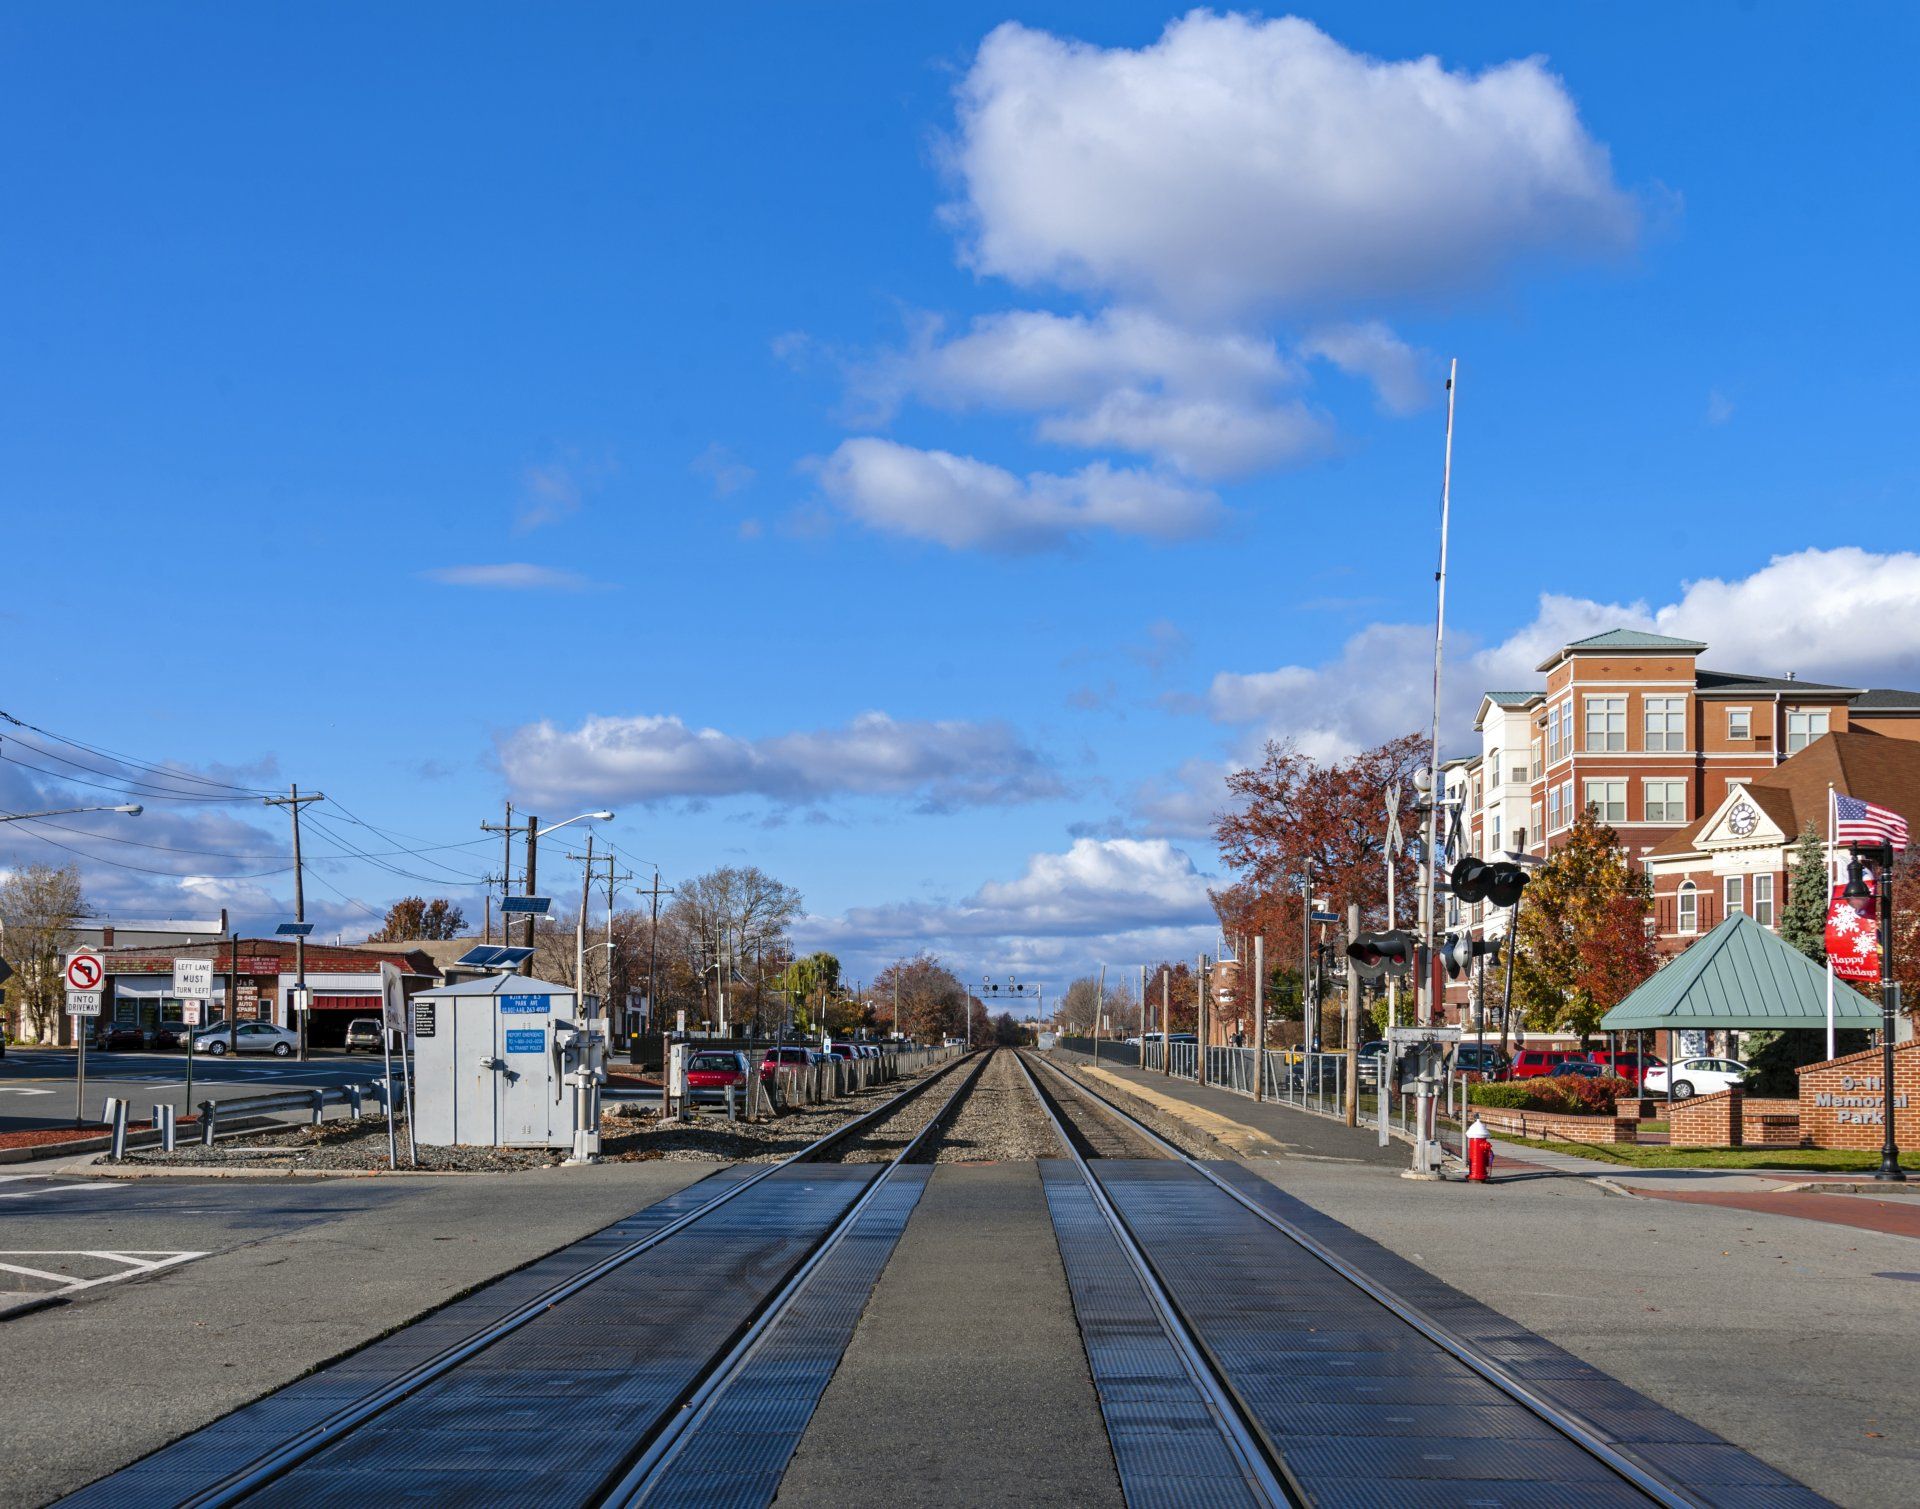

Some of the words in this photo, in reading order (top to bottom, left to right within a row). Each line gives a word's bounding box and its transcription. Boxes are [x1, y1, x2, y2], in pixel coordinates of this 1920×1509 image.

[1829, 953, 1864, 966] Happy
[178, 963, 192, 971] LEFT
[195, 964, 210, 972] LANE
[1834, 964, 1877, 978] Holidays
[183, 974, 204, 984] MUST
[176, 986, 192, 994] TURN
[194, 987, 209, 995] LEFT
[73, 995, 94, 1003] INTO
[68, 1003, 99, 1012] DRIVEWAY
[1842, 1076, 1881, 1091] 9-11
[1815, 1093, 1908, 1108] Memoral
[1837, 1110, 1884, 1125] Park
